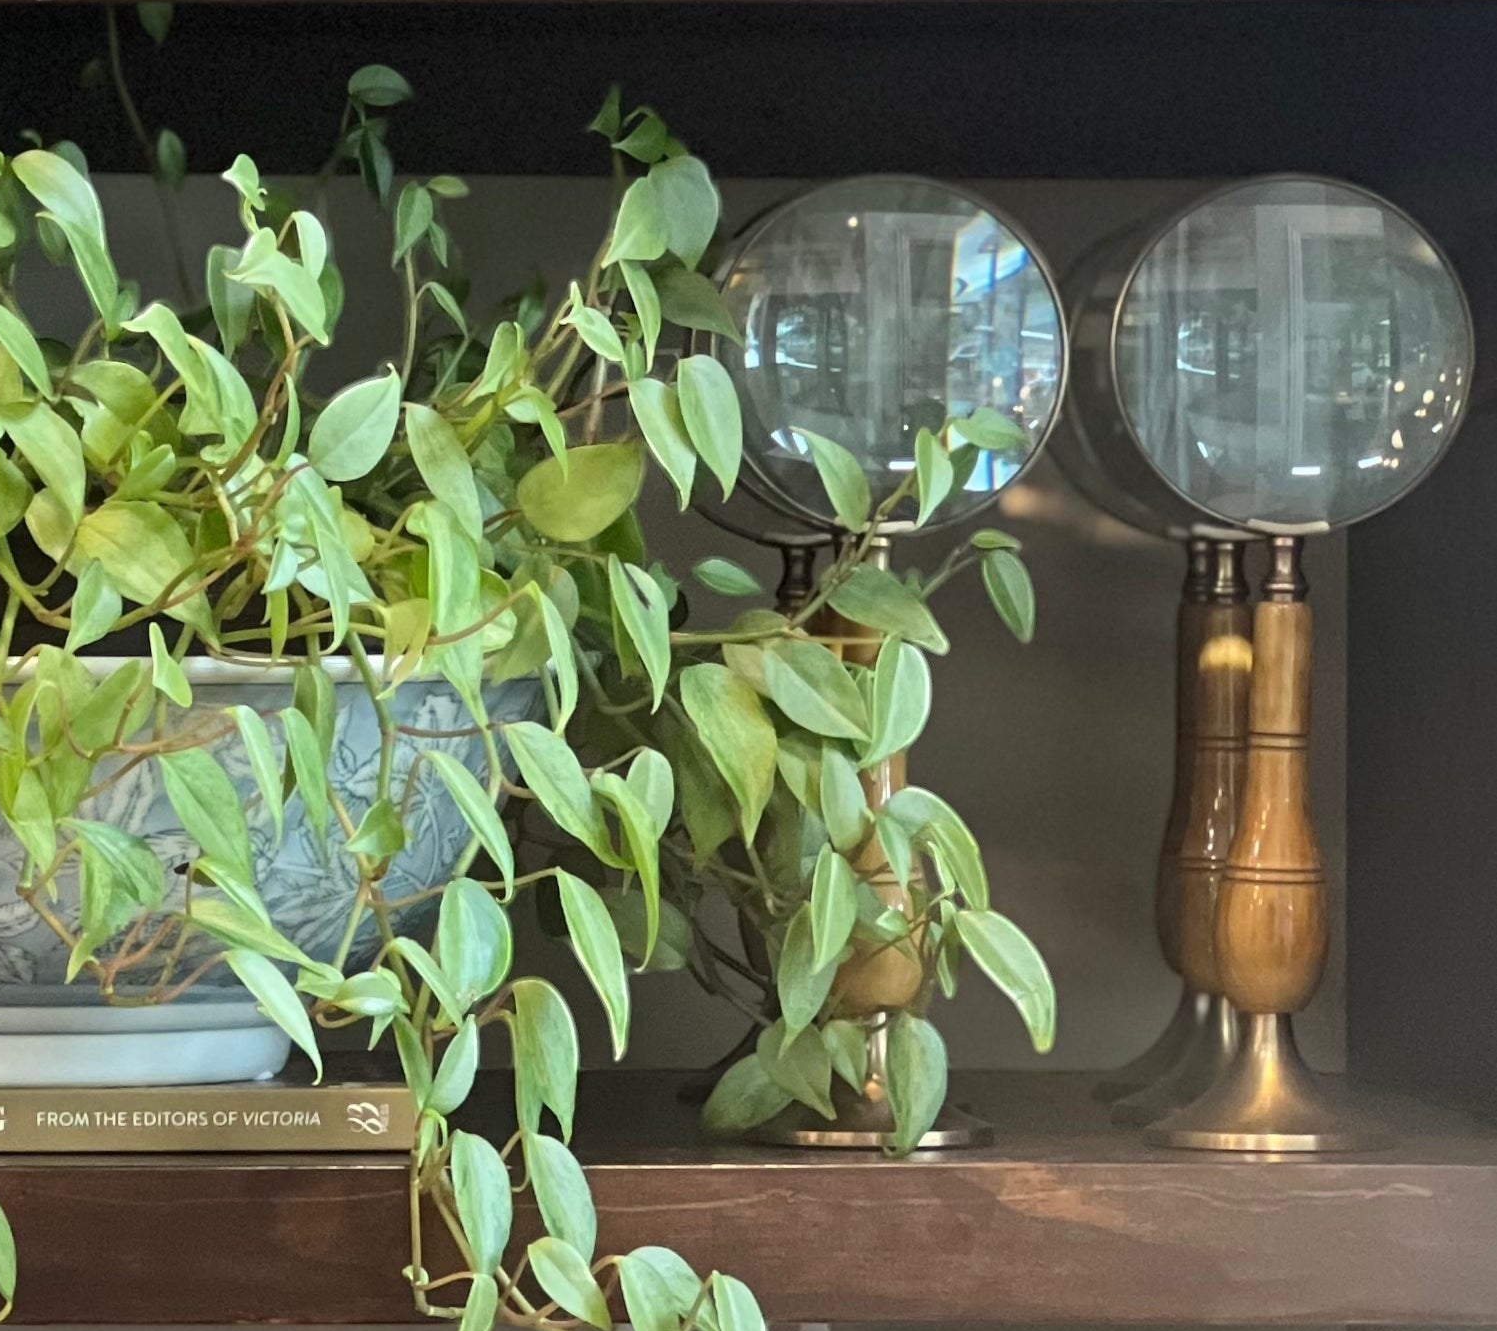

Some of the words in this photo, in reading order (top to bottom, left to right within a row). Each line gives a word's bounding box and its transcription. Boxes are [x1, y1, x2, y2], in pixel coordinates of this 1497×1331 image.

[36, 1111, 90, 1127] FROM
[94, 1111, 127, 1127] THE
[132, 1111, 207, 1127] EDITORS
[212, 1111, 238, 1127] OF
[242, 1111, 321, 1127] VICTORIA
